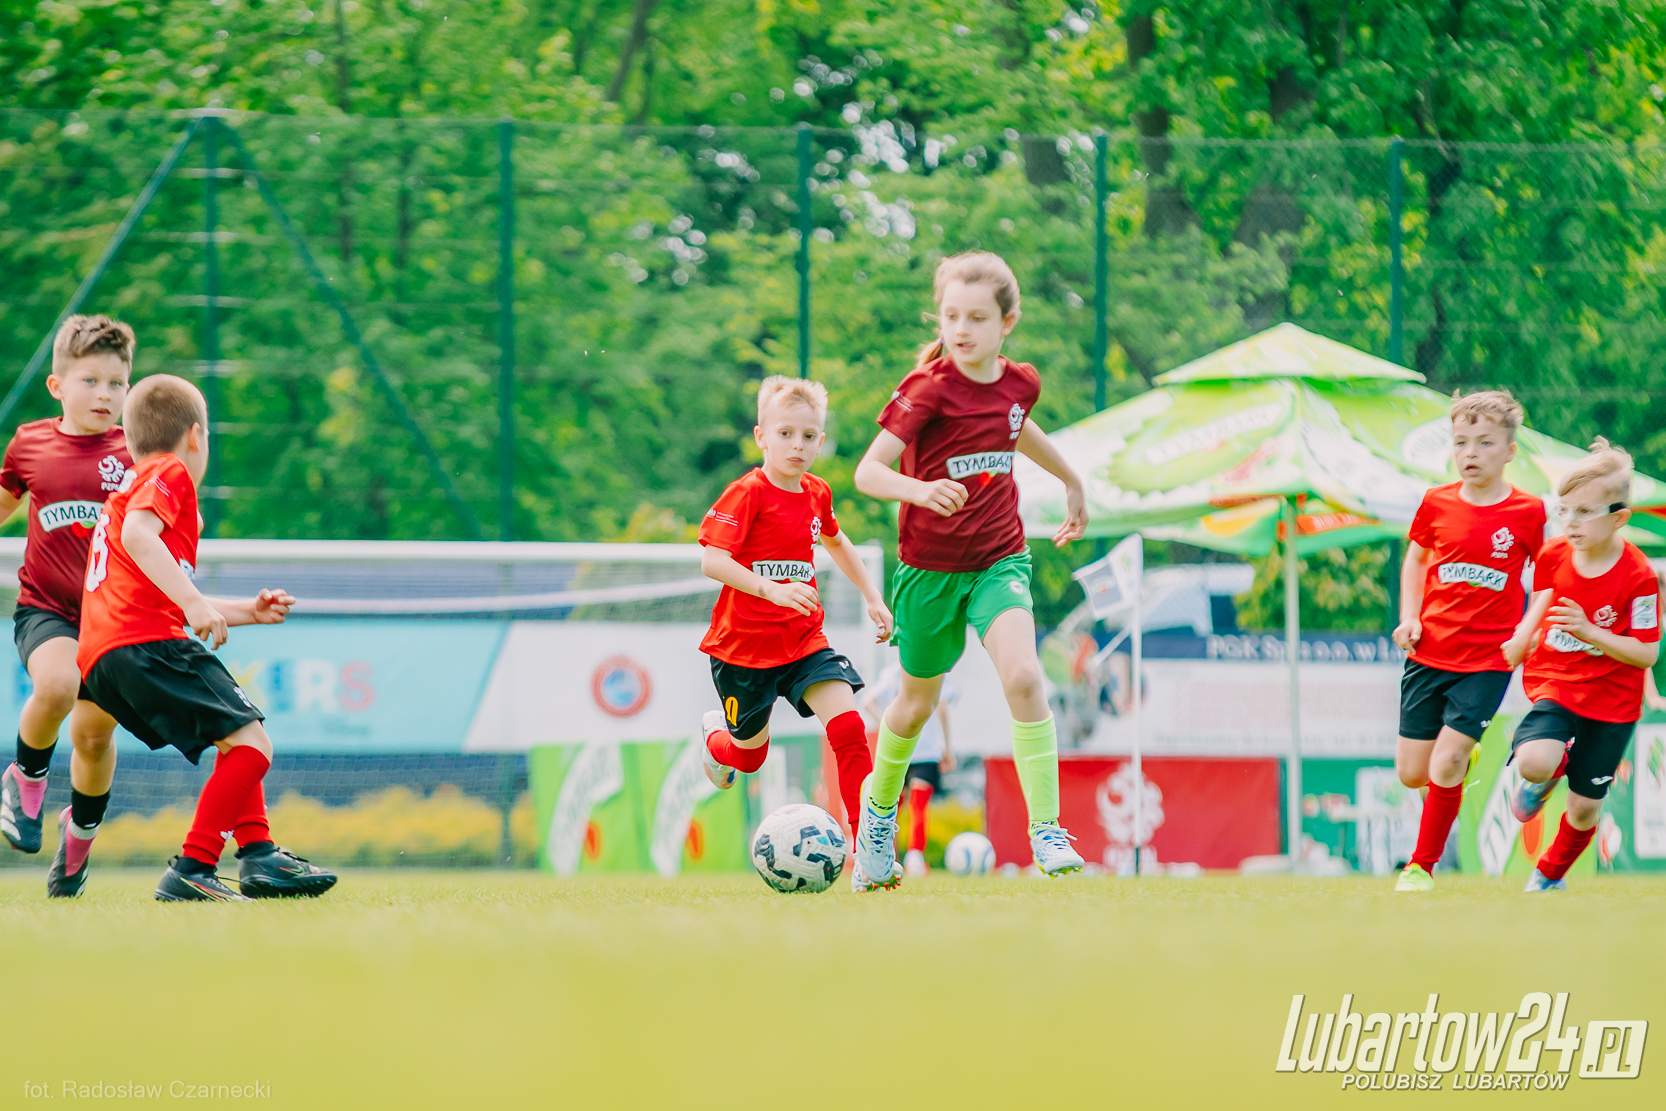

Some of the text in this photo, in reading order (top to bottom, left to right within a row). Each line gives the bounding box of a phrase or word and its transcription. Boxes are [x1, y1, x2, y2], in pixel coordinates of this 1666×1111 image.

[952, 455, 1012, 474] TYMBA
[43, 505, 103, 525] TYMBA
[1442, 566, 1505, 588] TYMBARK
[1206, 634, 1261, 659] PGK
